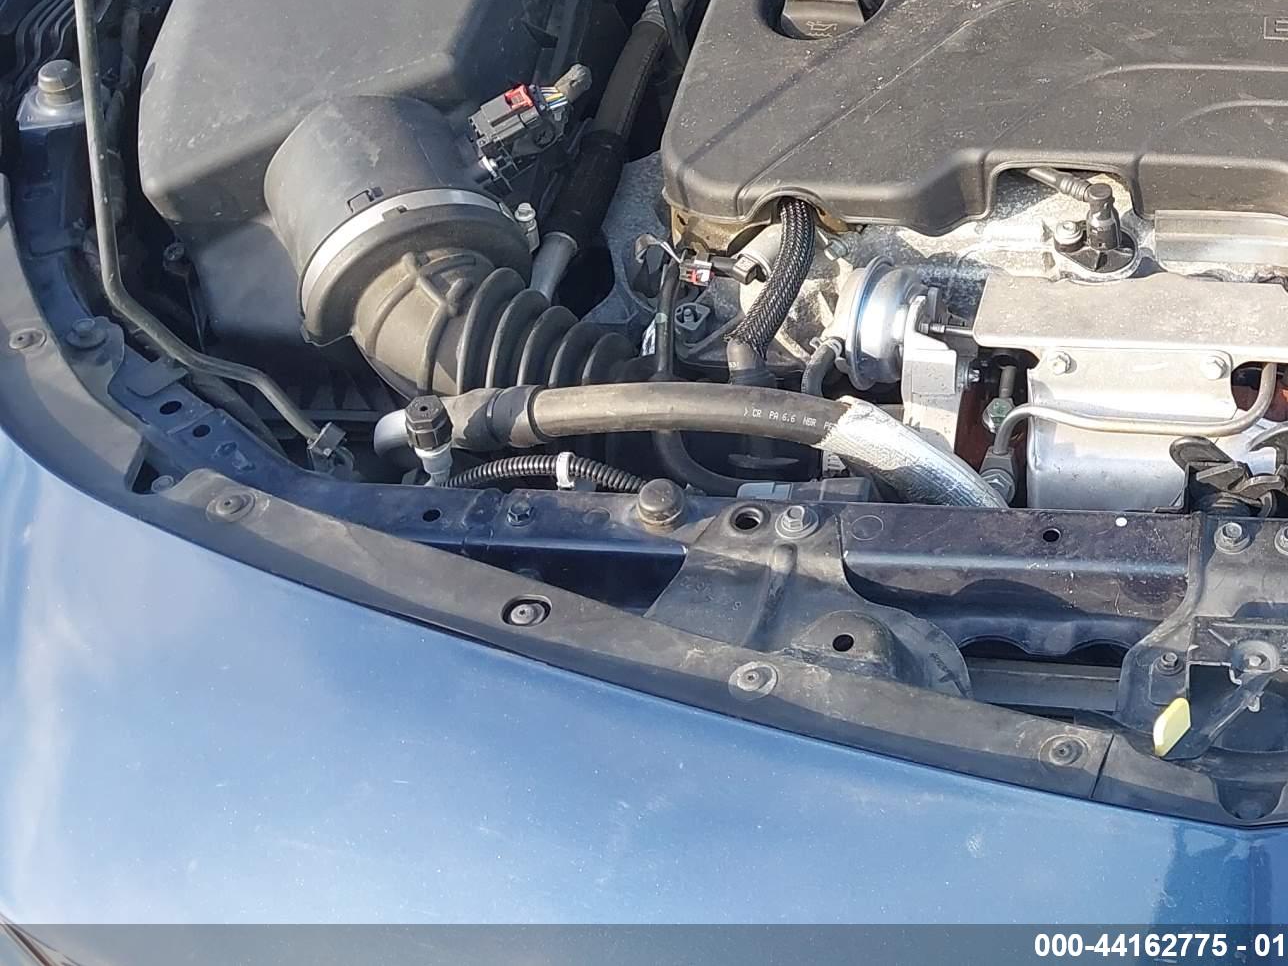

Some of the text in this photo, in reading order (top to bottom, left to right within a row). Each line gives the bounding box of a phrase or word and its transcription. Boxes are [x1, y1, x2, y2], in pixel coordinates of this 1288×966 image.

[752, 408, 762, 418] CR
[768, 410, 779, 420] PA
[781, 412, 796, 423] 6.6
